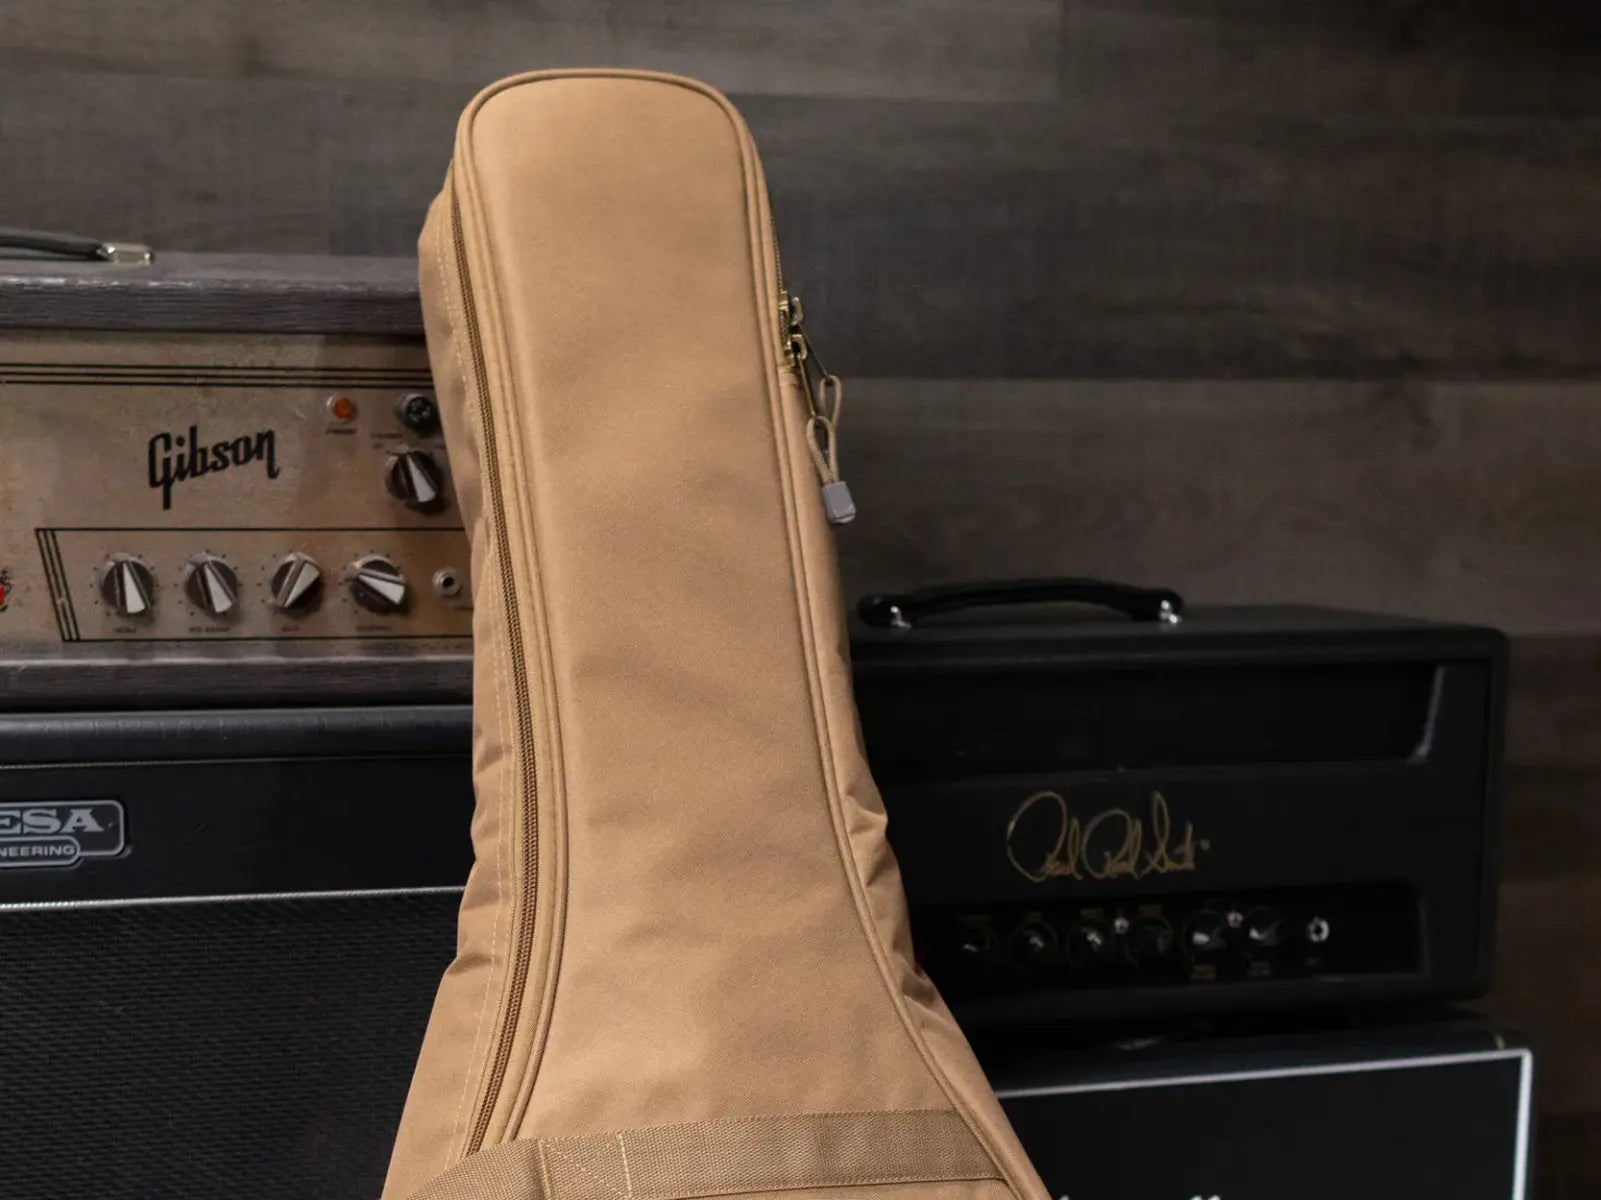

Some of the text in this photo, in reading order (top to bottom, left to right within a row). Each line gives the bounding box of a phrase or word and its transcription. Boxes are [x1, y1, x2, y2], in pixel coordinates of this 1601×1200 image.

[148, 425, 280, 511] Gibson
[0, 808, 105, 835] ESA
[0, 845, 77, 858] NEERING
